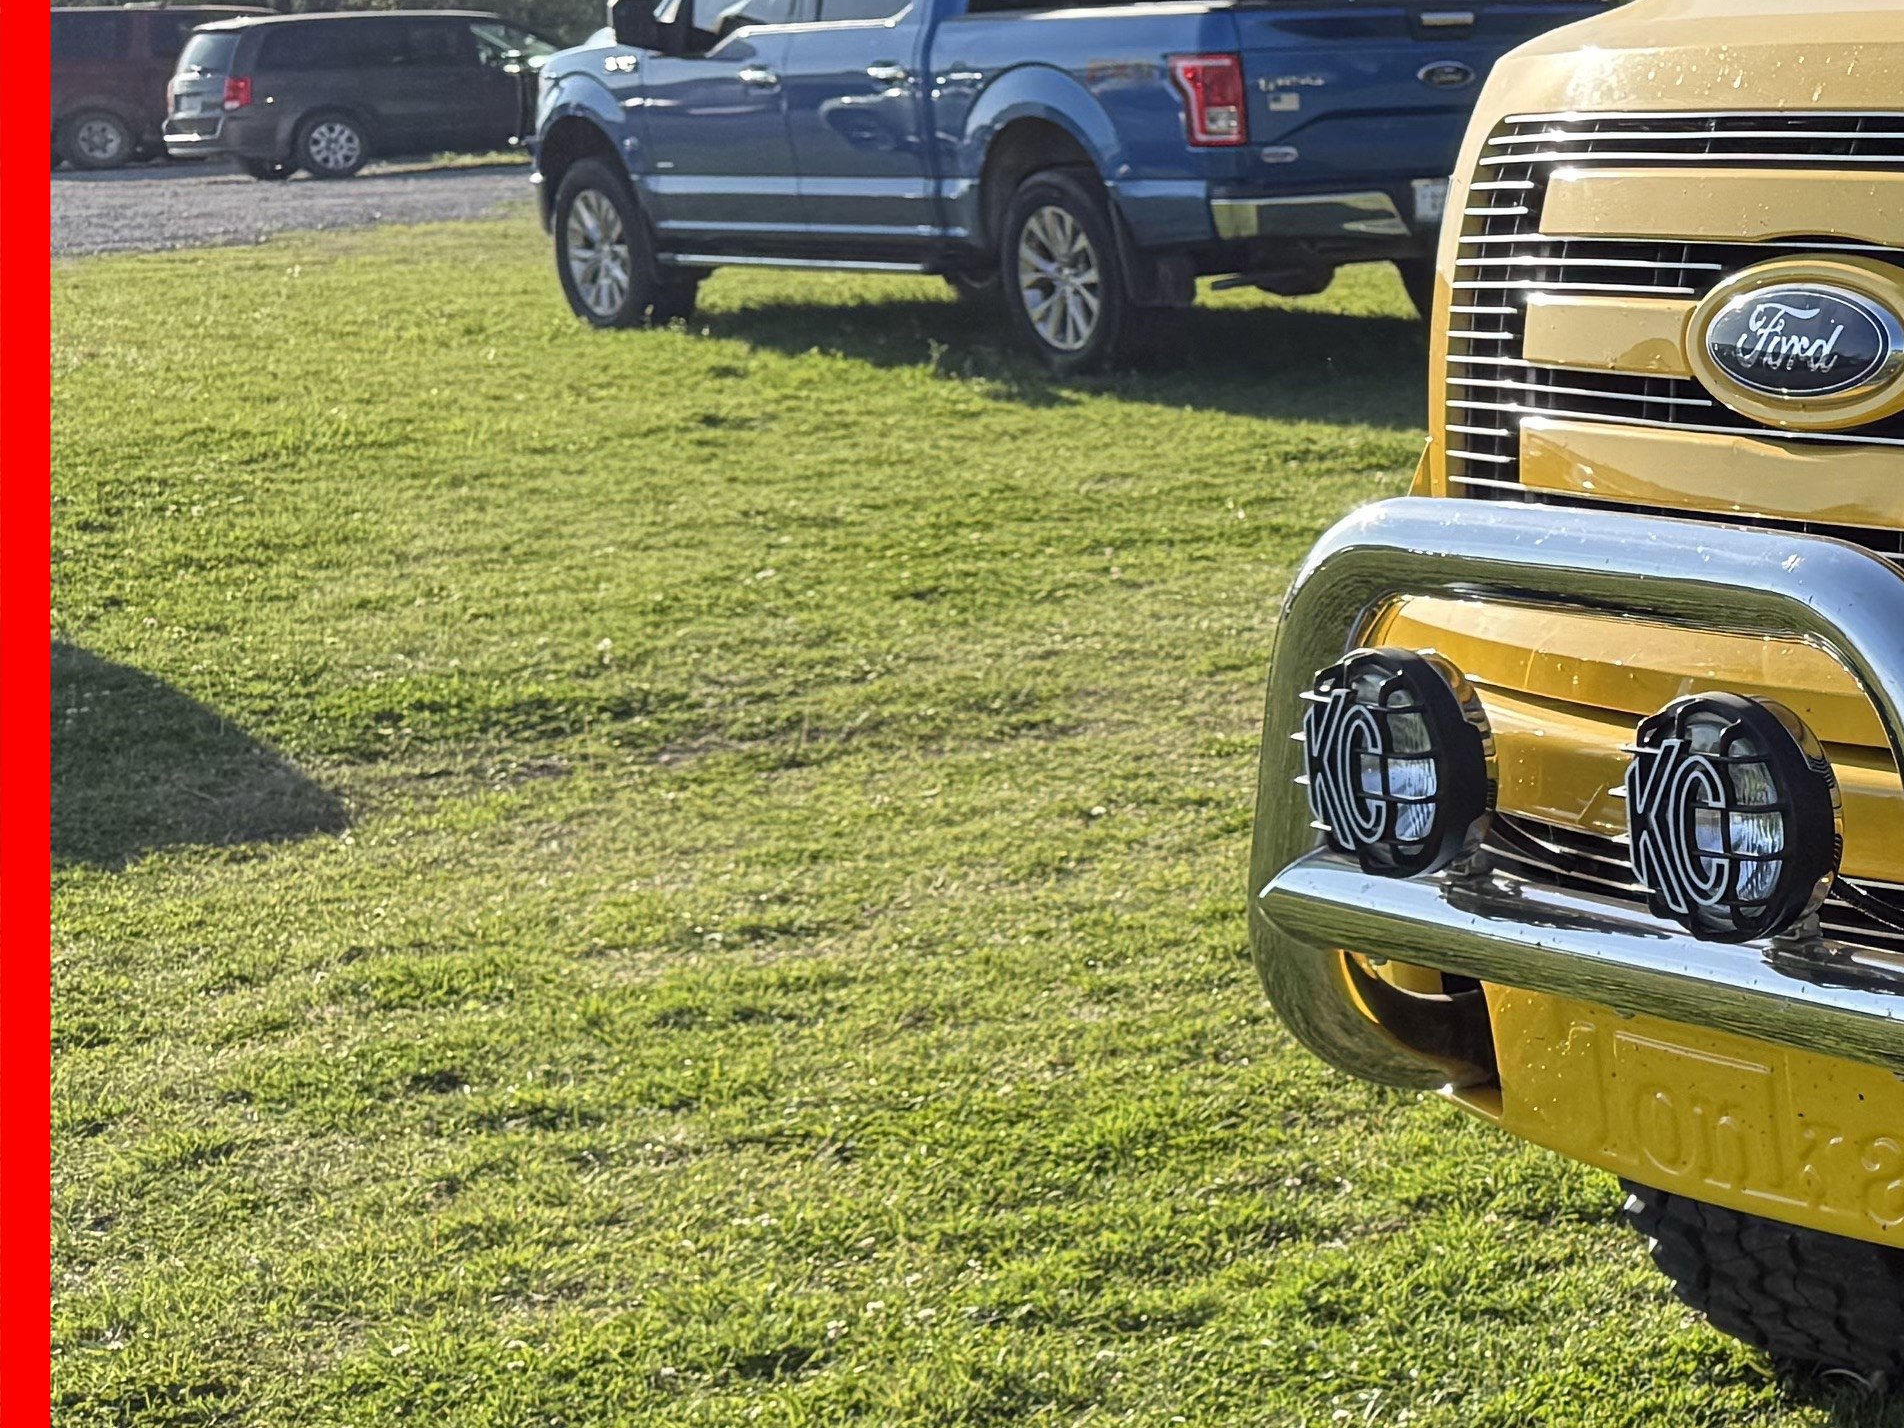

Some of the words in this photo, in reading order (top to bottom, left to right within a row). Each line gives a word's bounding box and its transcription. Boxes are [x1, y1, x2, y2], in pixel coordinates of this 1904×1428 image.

[1735, 302, 1845, 373] Ford
[1303, 687, 1388, 851] KC
[1623, 738, 1730, 915] KC
